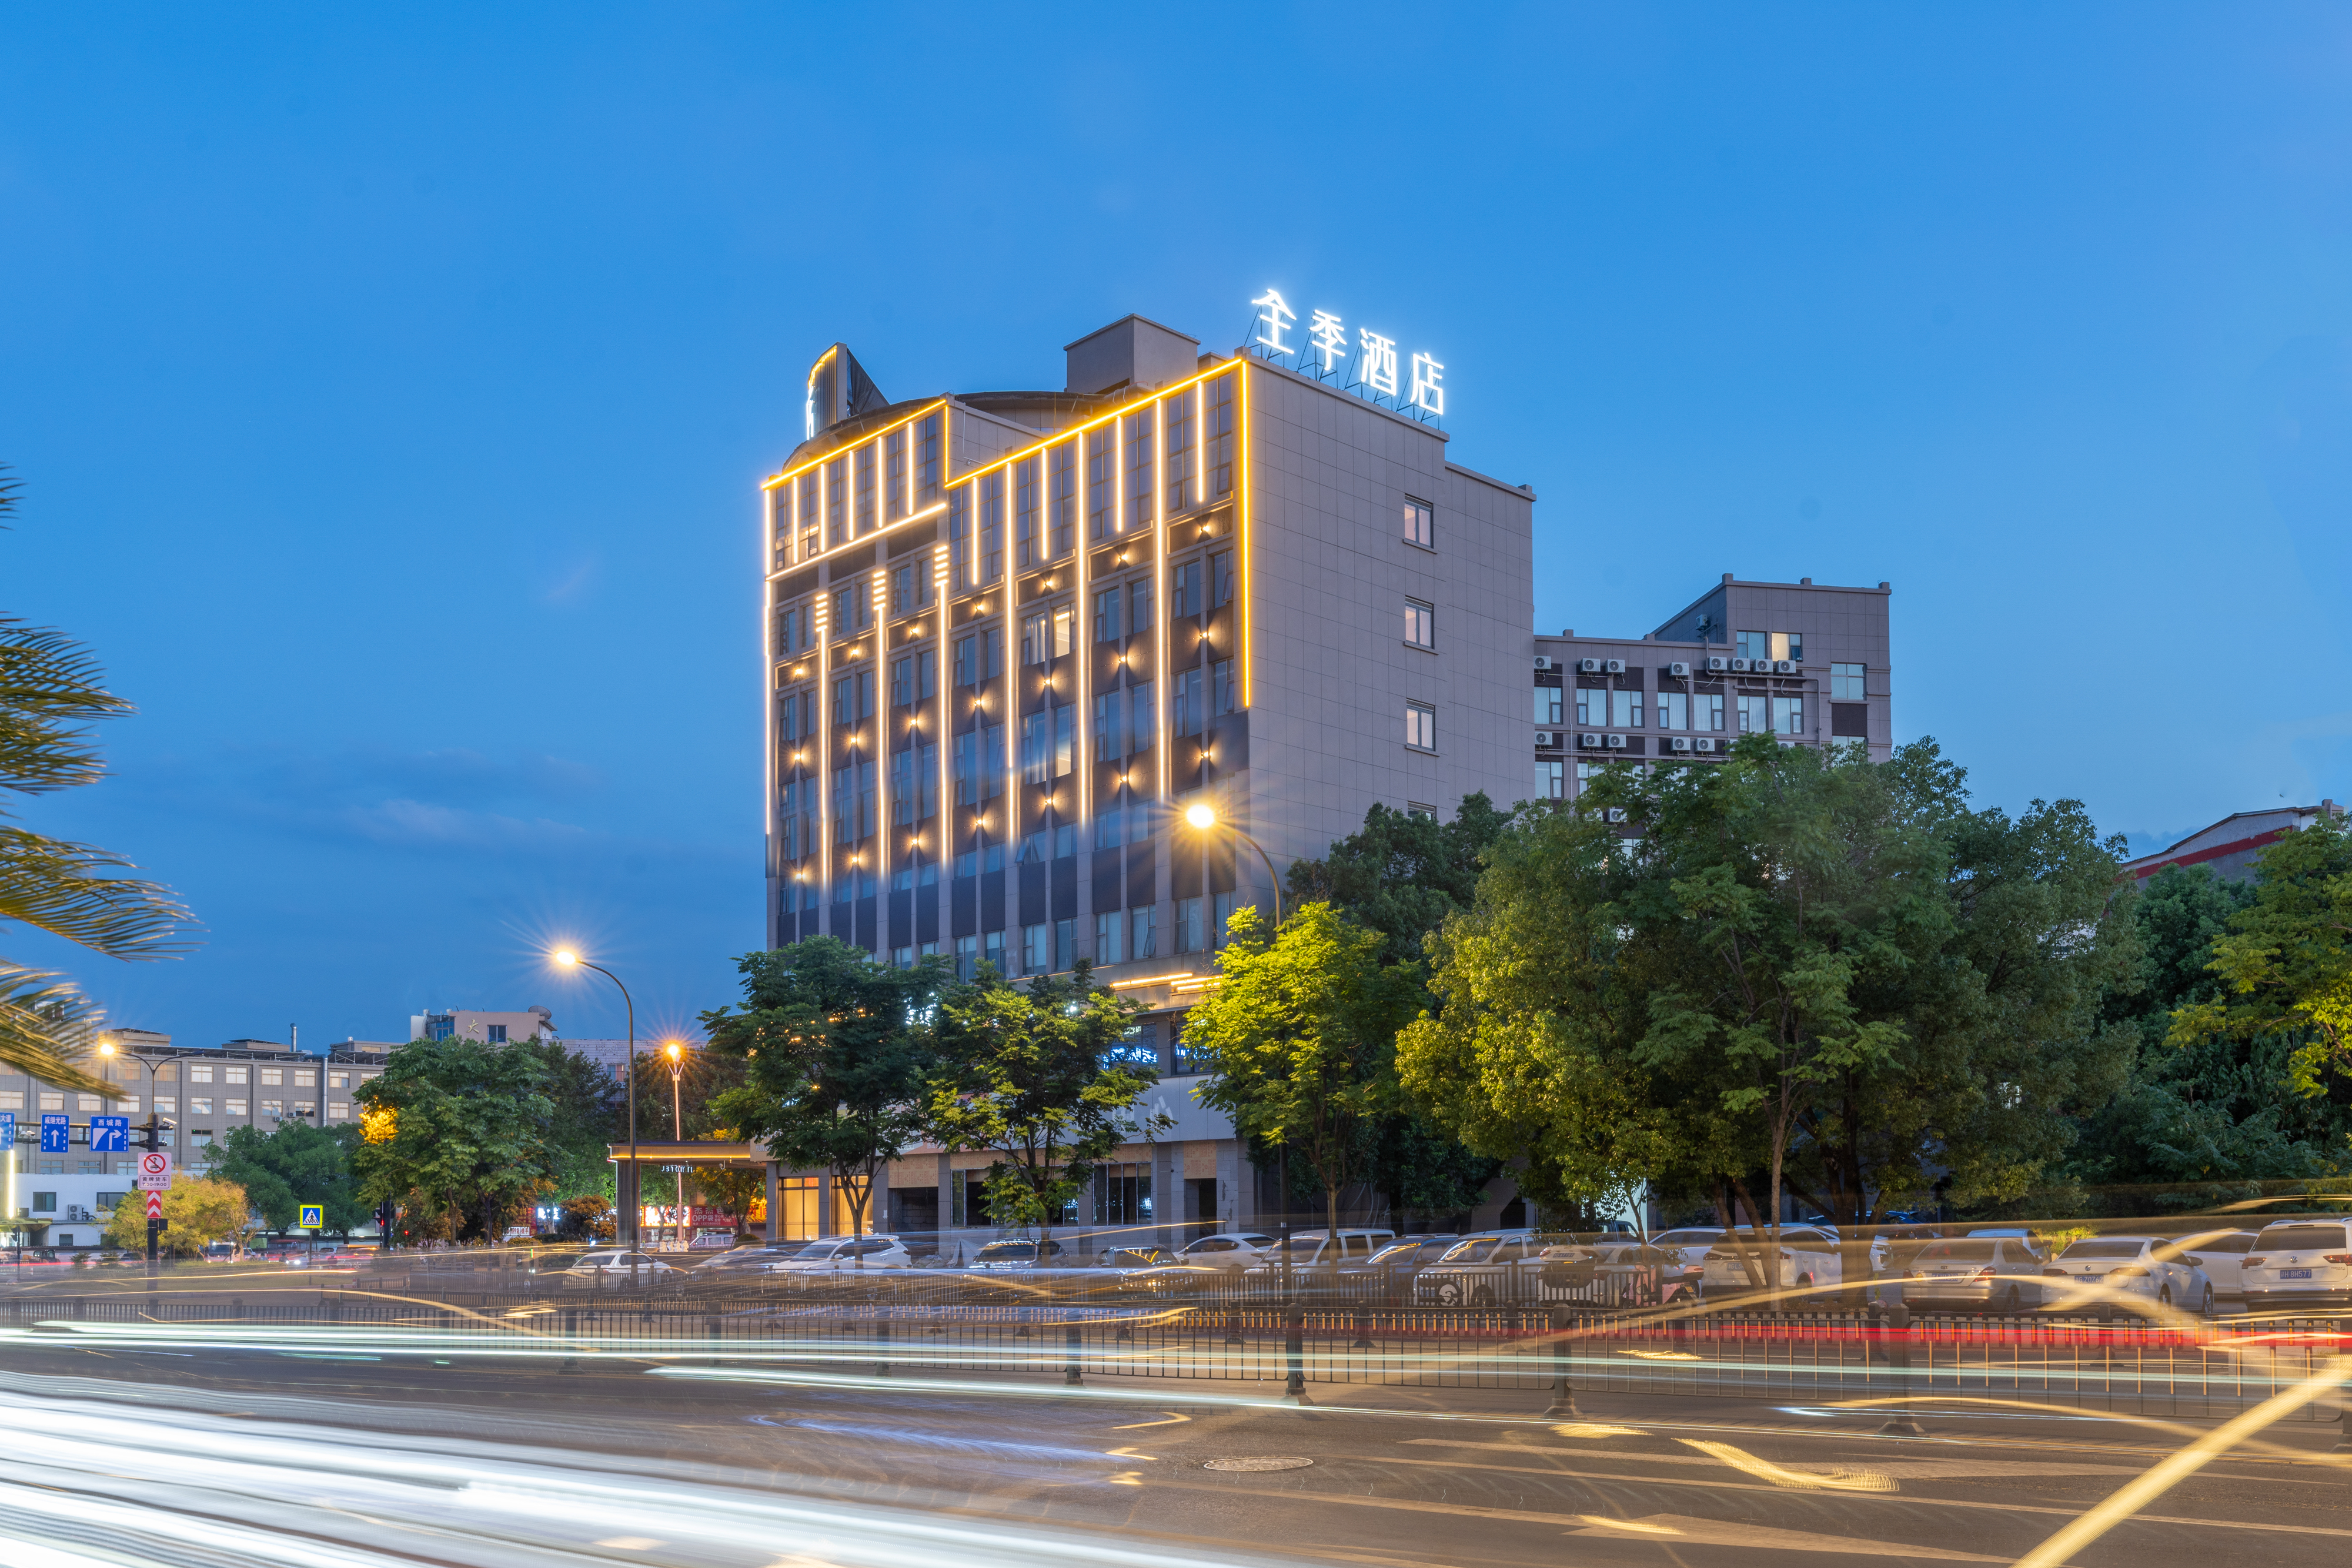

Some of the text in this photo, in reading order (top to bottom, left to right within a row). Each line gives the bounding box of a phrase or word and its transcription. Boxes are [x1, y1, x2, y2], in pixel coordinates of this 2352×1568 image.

[1252, 289, 1444, 415] 全季酒店
[466, 1019, 479, 1034] 大
[0, 1114, 12, 1122] 大道
[45, 1116, 66, 1125] 戚继光路
